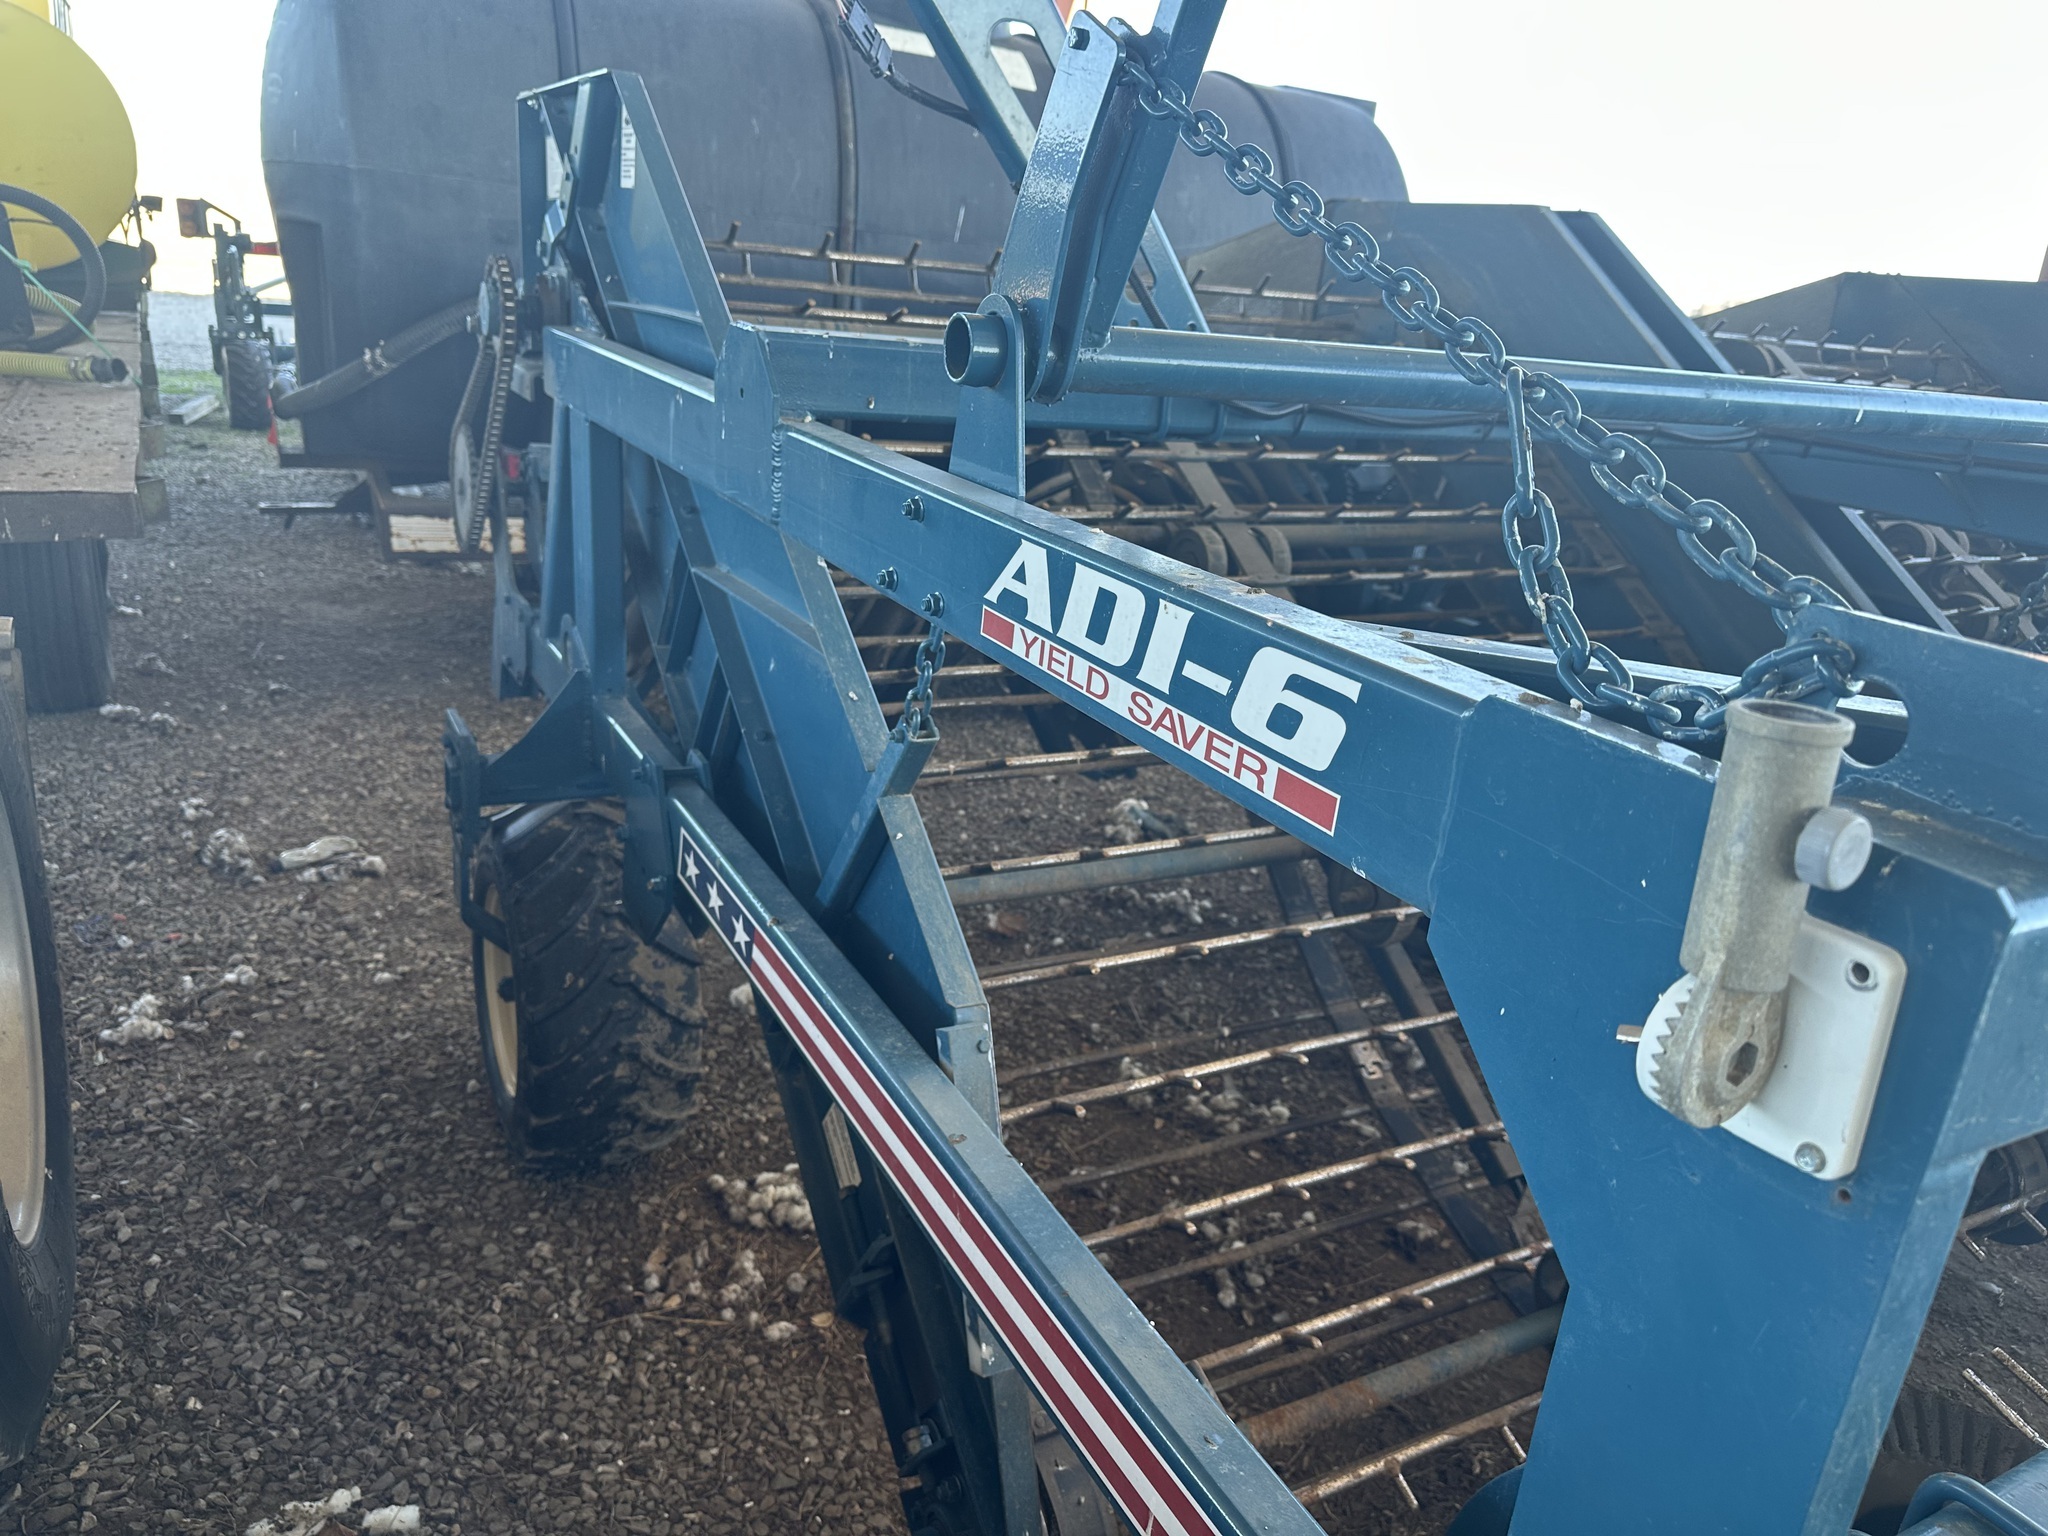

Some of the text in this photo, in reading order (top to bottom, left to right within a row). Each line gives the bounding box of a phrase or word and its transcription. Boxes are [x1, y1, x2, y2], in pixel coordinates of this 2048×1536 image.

[983, 539, 1362, 772] ADI-6
[1019, 628, 1268, 794] YIELD SAVER
